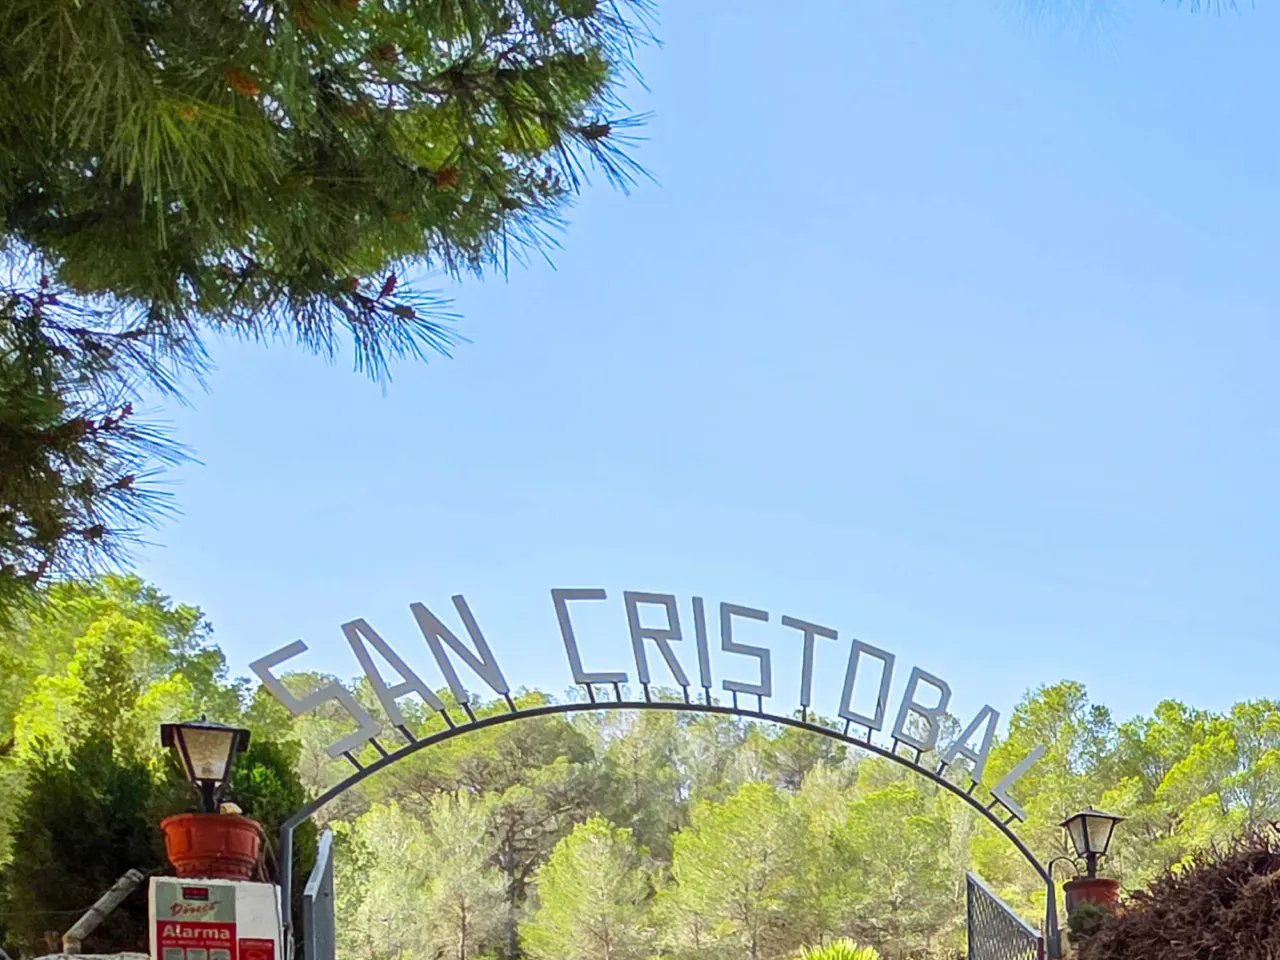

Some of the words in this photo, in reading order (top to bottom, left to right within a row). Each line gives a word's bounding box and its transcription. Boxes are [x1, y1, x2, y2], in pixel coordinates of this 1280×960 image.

[248, 594, 511, 759] SAN
[550, 588, 1046, 822] CRISTOBAL
[162, 924, 231, 940] Alarma
